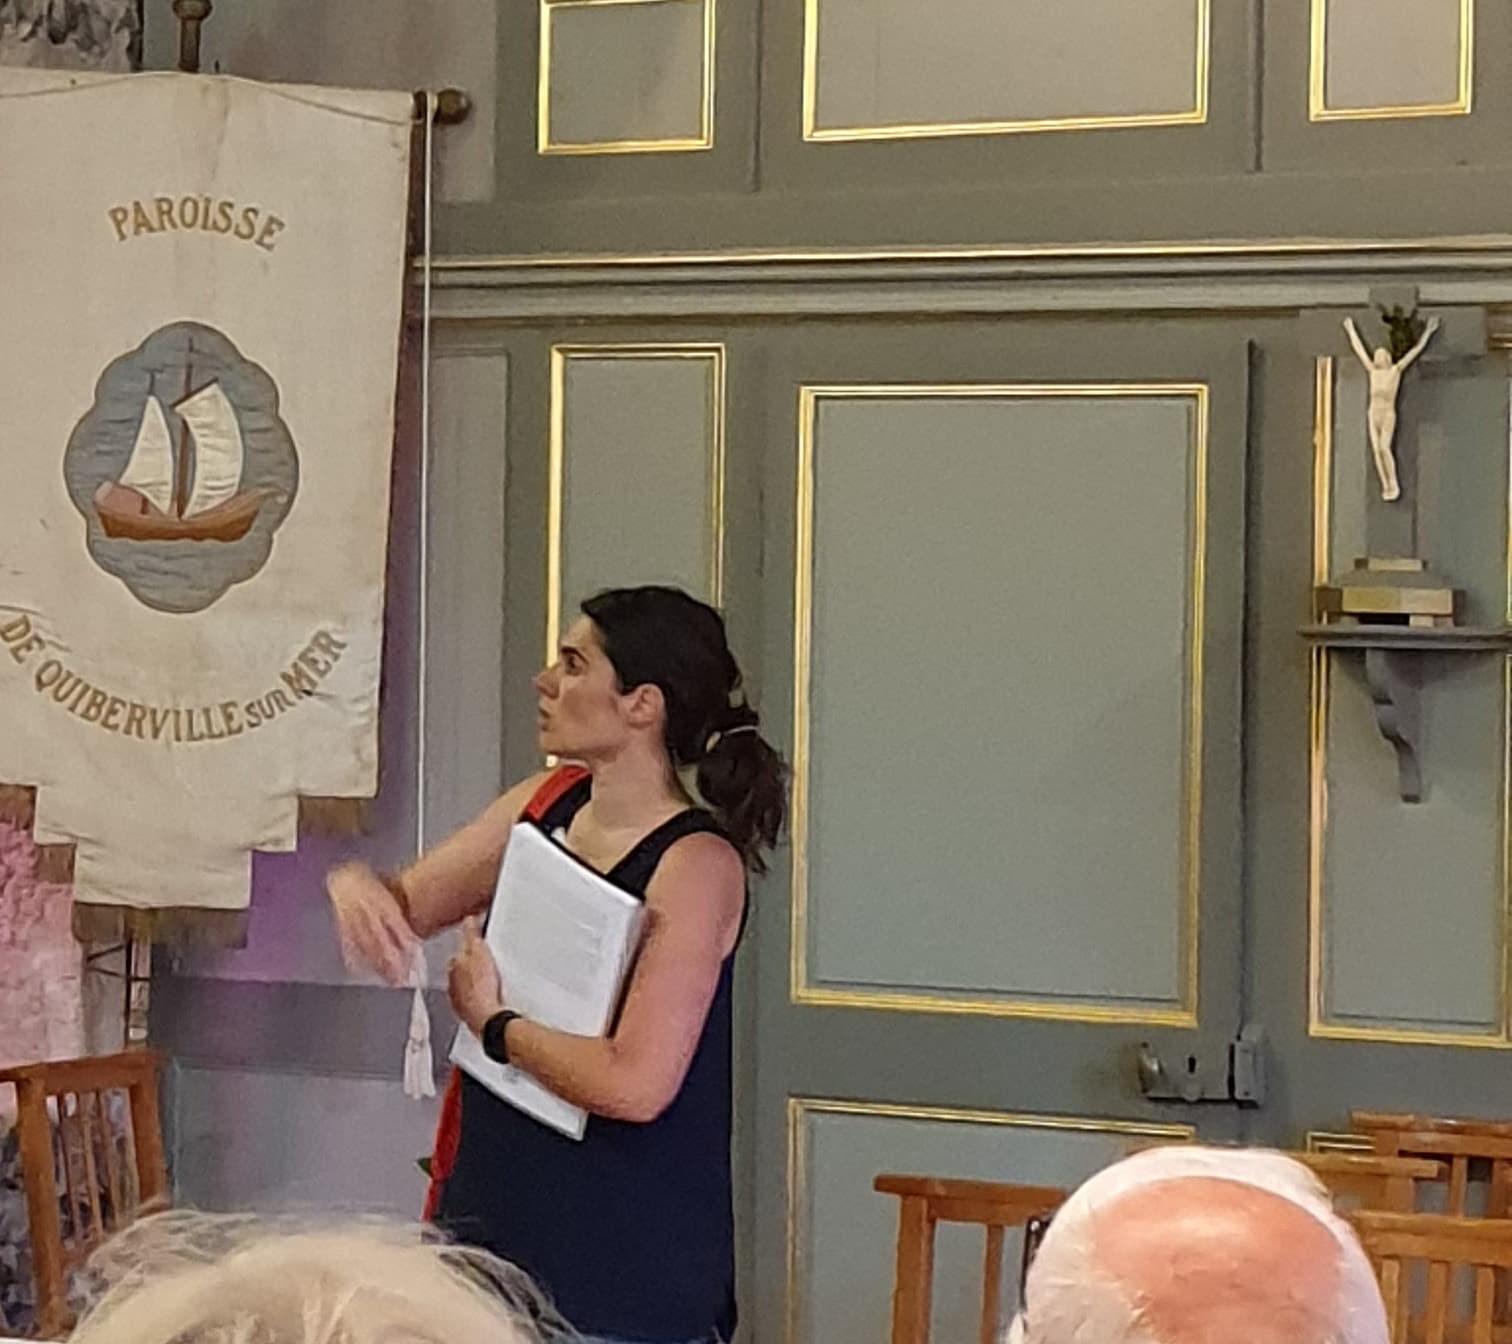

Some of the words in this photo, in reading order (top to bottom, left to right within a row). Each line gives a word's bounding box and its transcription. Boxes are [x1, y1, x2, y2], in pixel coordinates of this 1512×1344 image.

[108, 195, 286, 253] PAROISSE
[34, 658, 244, 742] QUIBERVILLE
[244, 688, 296, 729] SUR
[279, 630, 348, 701] MER
